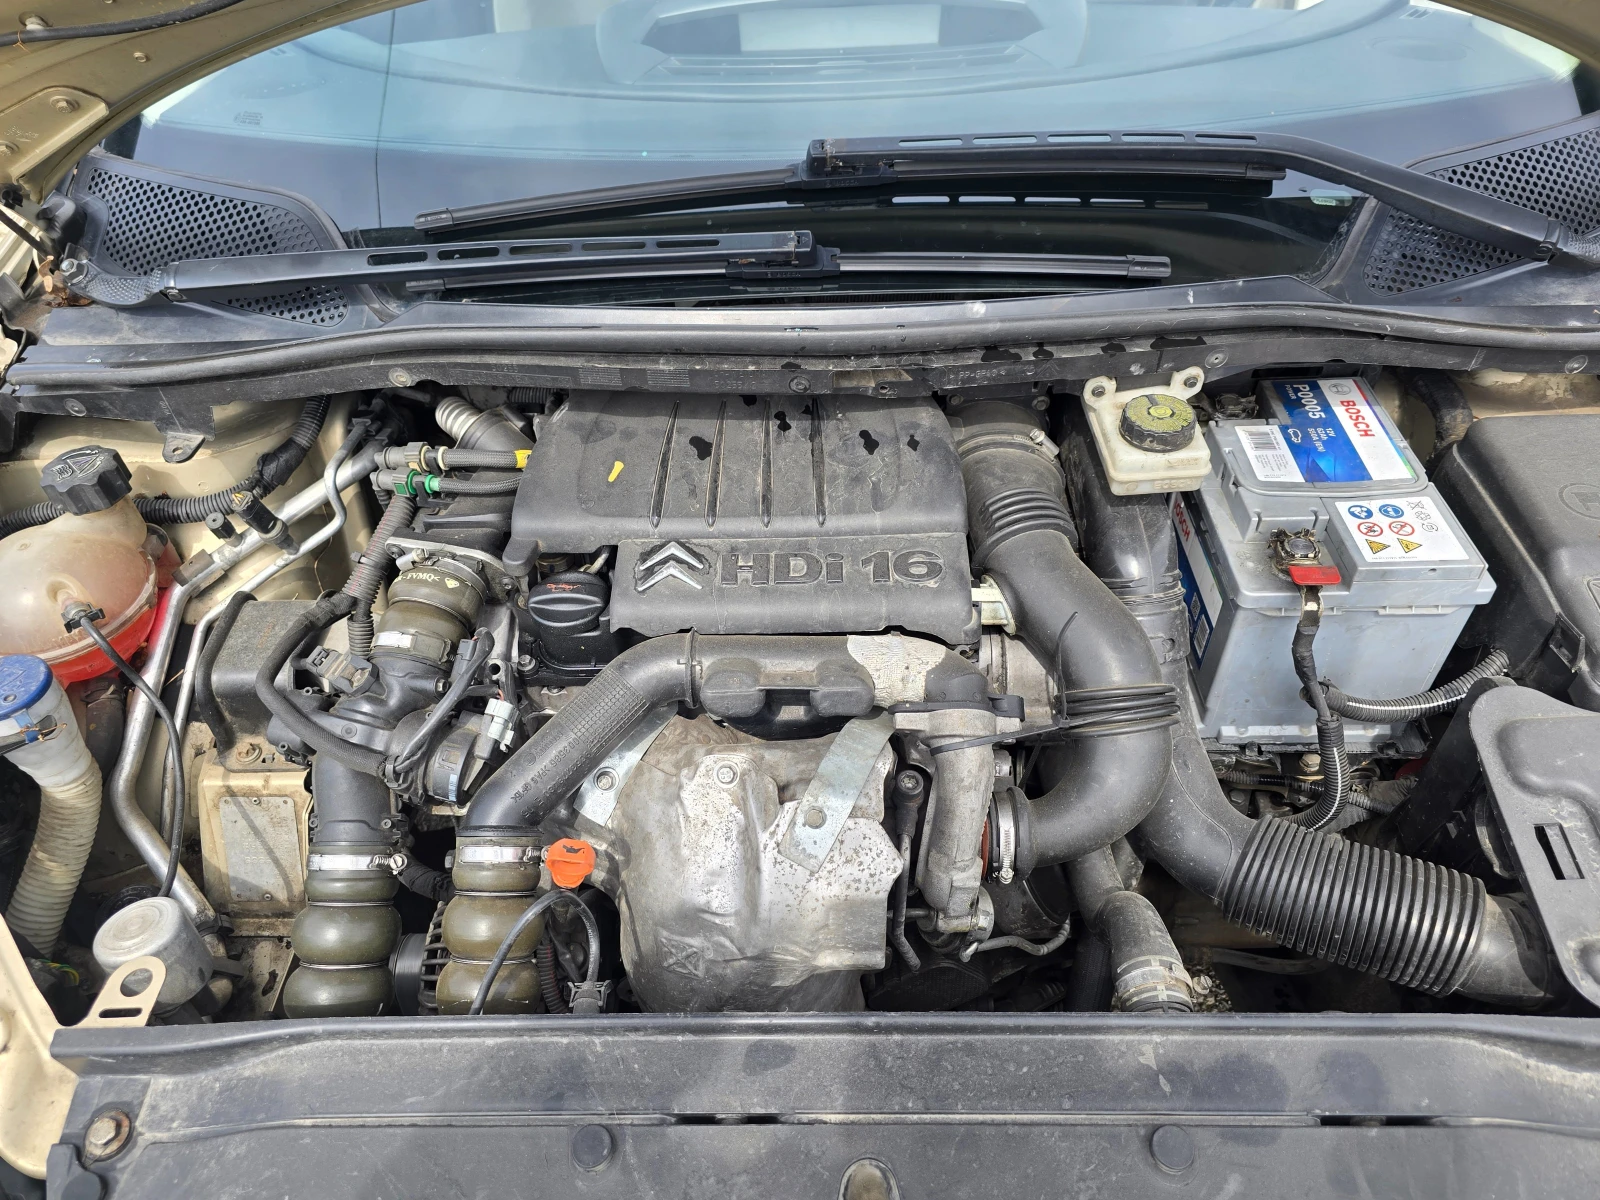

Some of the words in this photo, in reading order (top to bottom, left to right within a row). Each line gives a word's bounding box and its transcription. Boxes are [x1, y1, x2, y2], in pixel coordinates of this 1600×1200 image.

[1284, 383, 1298, 400] POWER
[1292, 383, 1327, 419] P0005
[1340, 400, 1376, 437] BOSCH
[1175, 500, 1191, 542] OSCH
[720, 551, 845, 586] HDi
[861, 549, 945, 584] 16
